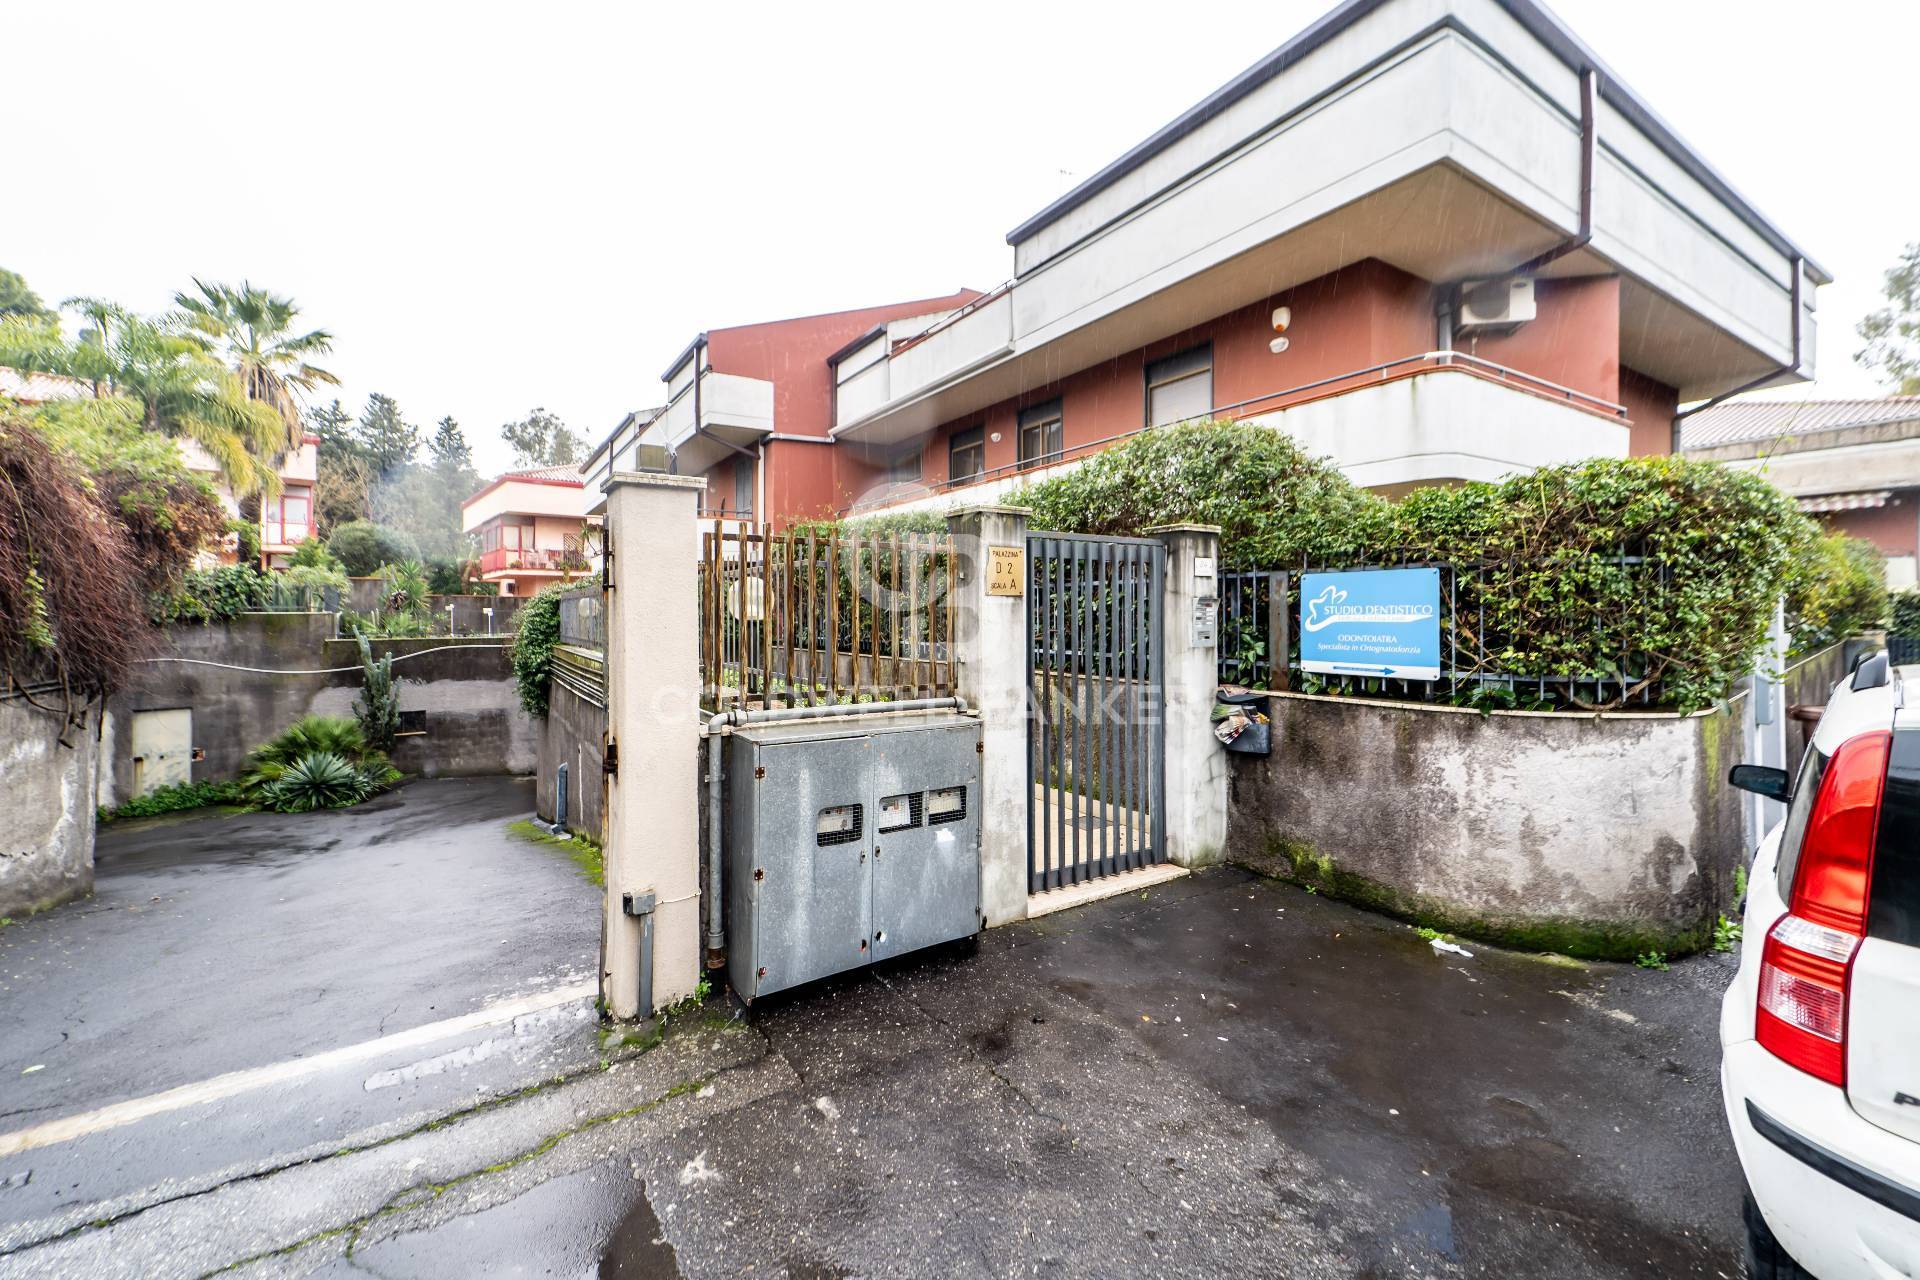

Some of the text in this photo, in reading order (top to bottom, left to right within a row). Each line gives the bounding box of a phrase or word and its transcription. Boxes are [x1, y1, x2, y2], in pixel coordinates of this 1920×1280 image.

[992, 550, 1019, 558] PALAZZINA
[995, 561, 1013, 574] D 2
[990, 578, 1017, 590] SCALA A
[1324, 604, 1433, 615] STUDIO DENTISTICO
[1337, 634, 1398, 644] ODONTOIATRA
[1318, 643, 1351, 652] Specialista
[1360, 645, 1421, 655] Ortognatodonzia
